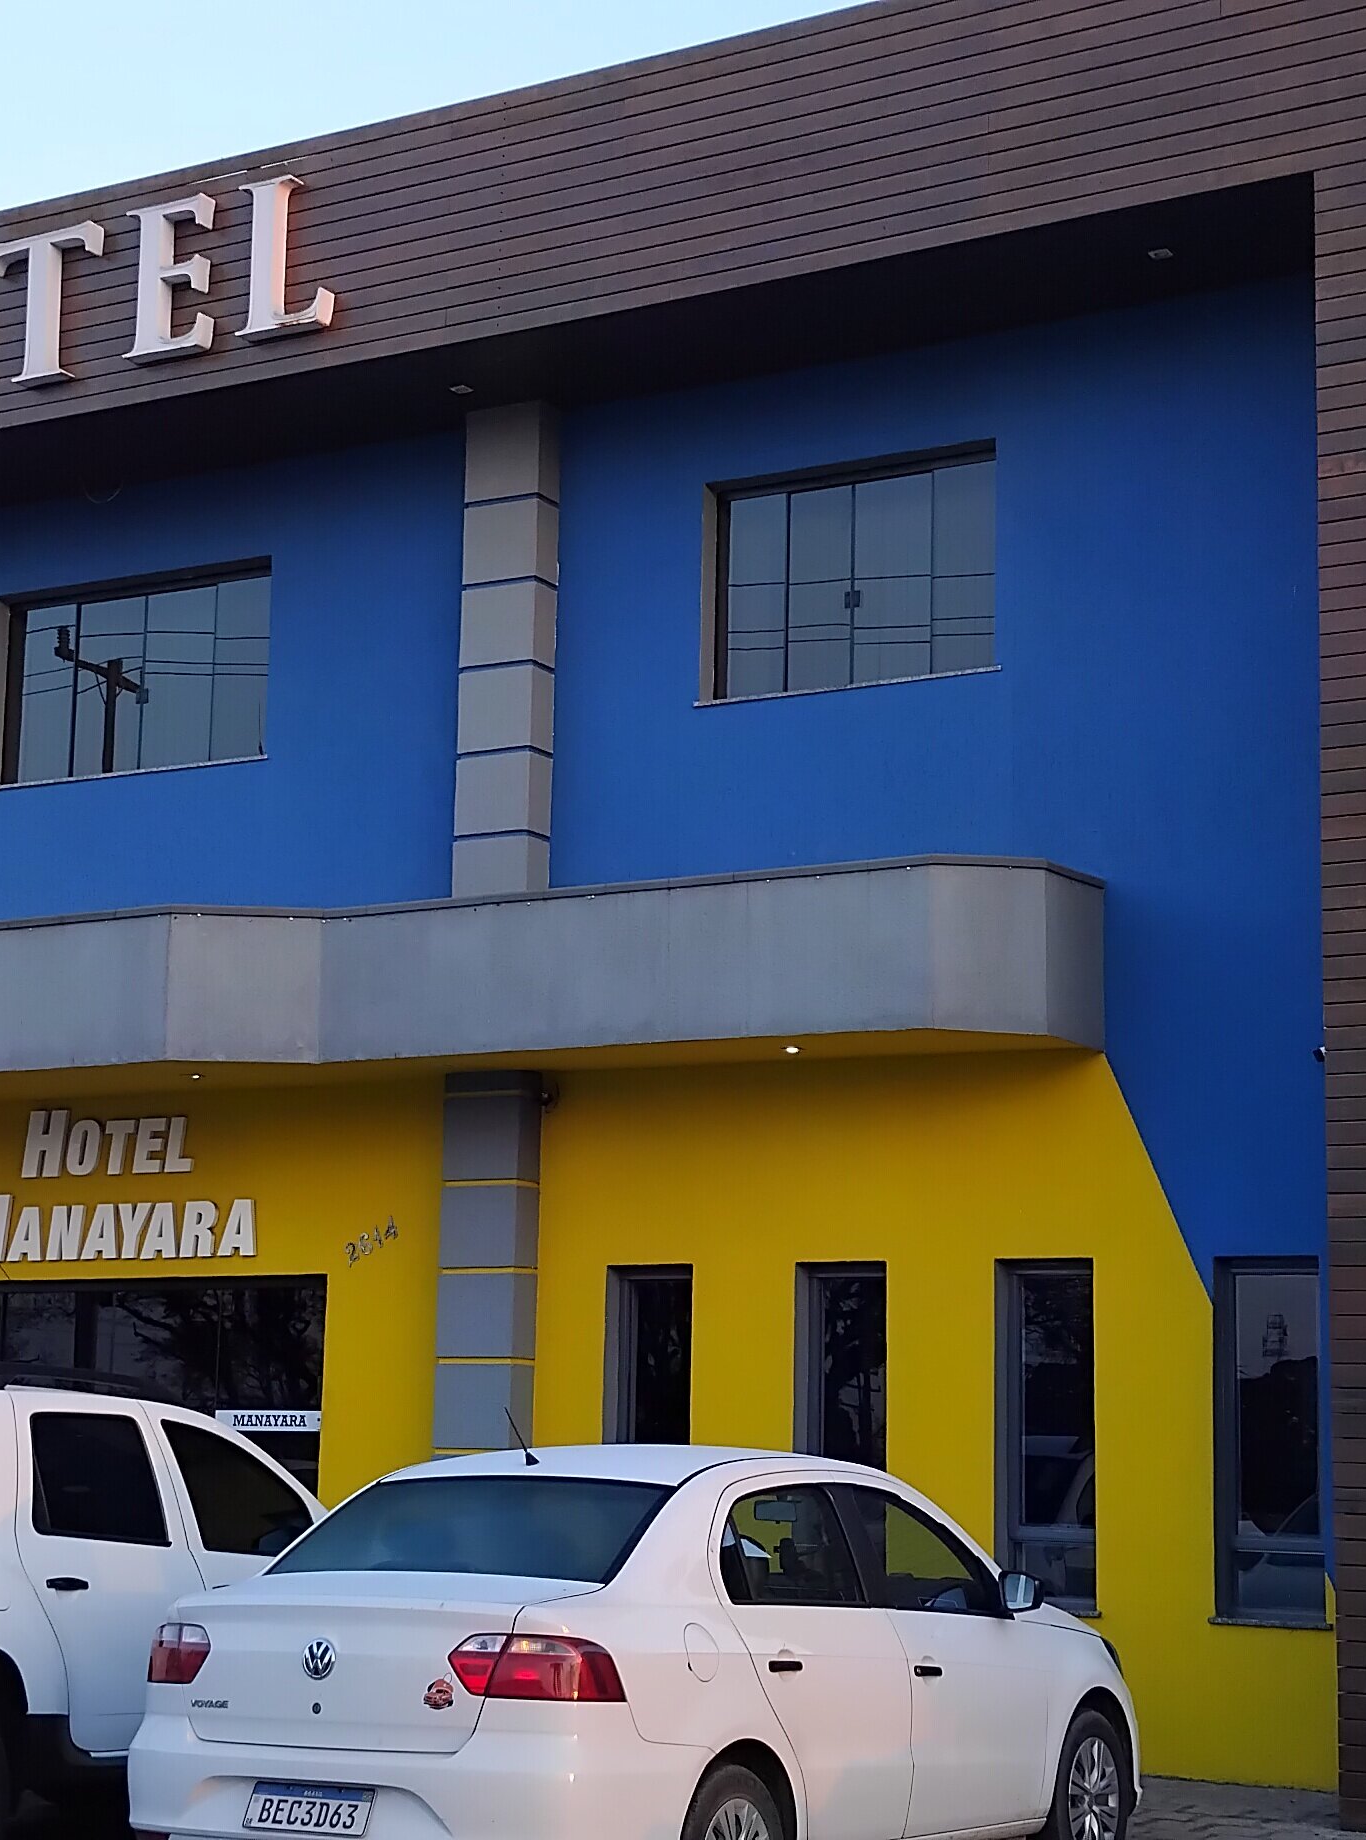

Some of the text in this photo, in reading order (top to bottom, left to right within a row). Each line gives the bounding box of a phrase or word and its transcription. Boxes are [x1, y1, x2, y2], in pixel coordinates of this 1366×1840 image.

[21, 1109, 195, 1178] HOTEL
[345, 1215, 399, 1268] 2614
[232, 1414, 307, 1427] MANAYARA
[190, 1699, 229, 1709] VOYAGE
[257, 1798, 359, 1829] BEC3D63
